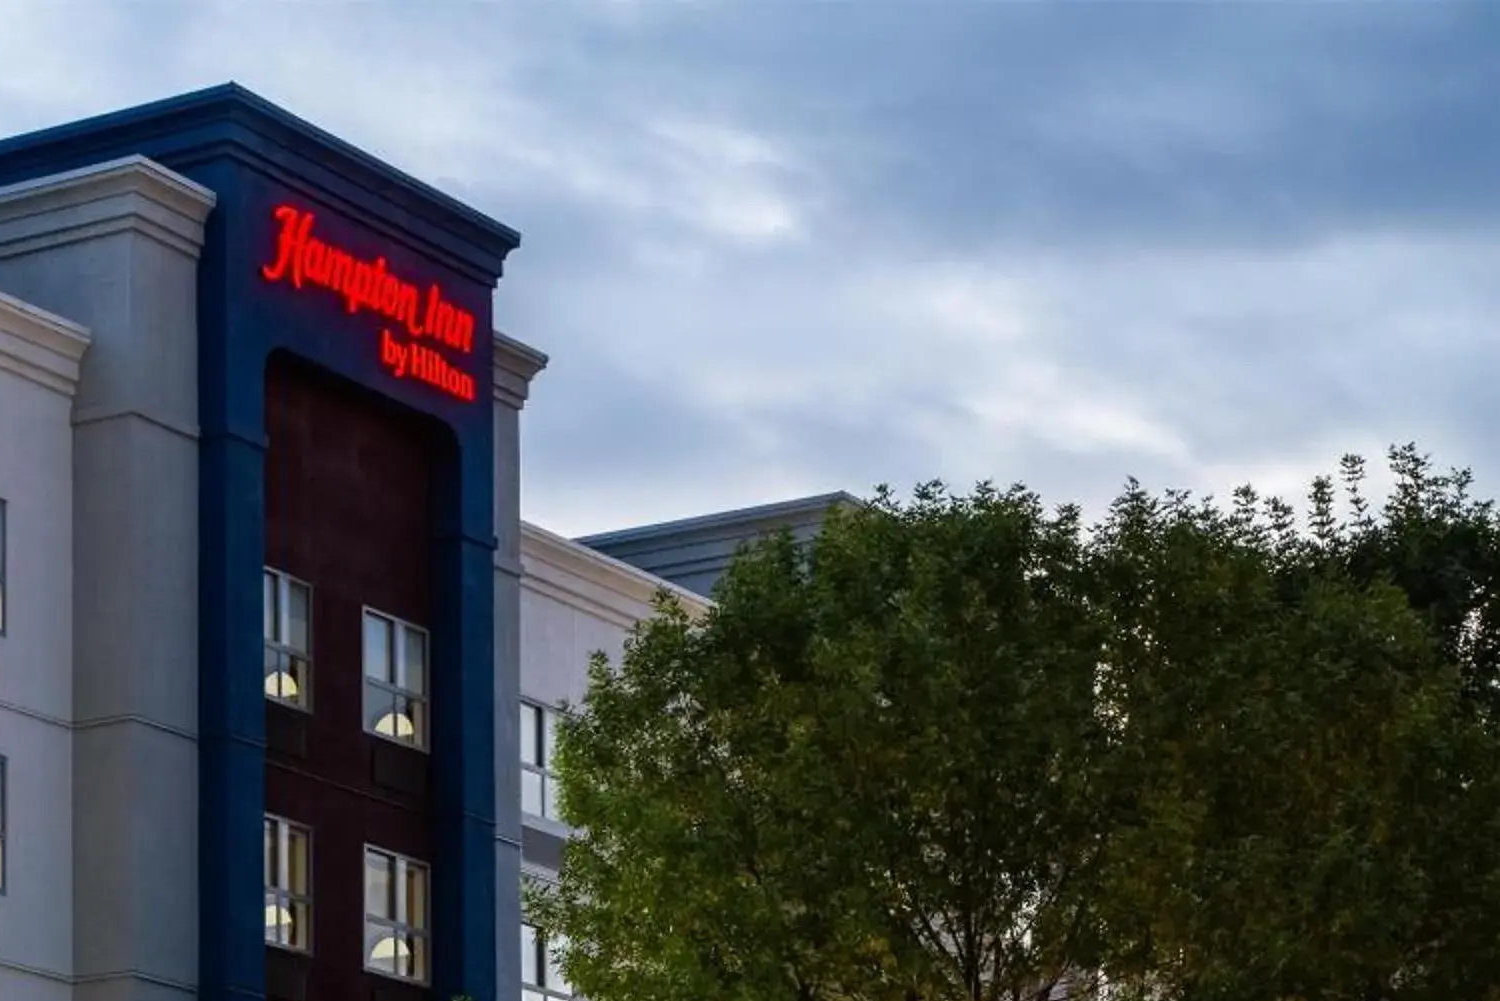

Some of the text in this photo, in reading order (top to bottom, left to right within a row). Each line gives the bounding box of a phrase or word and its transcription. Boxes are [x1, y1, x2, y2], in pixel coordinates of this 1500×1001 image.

[263, 206, 475, 352] Hampton Inn
[382, 329, 476, 402] by Hilton
